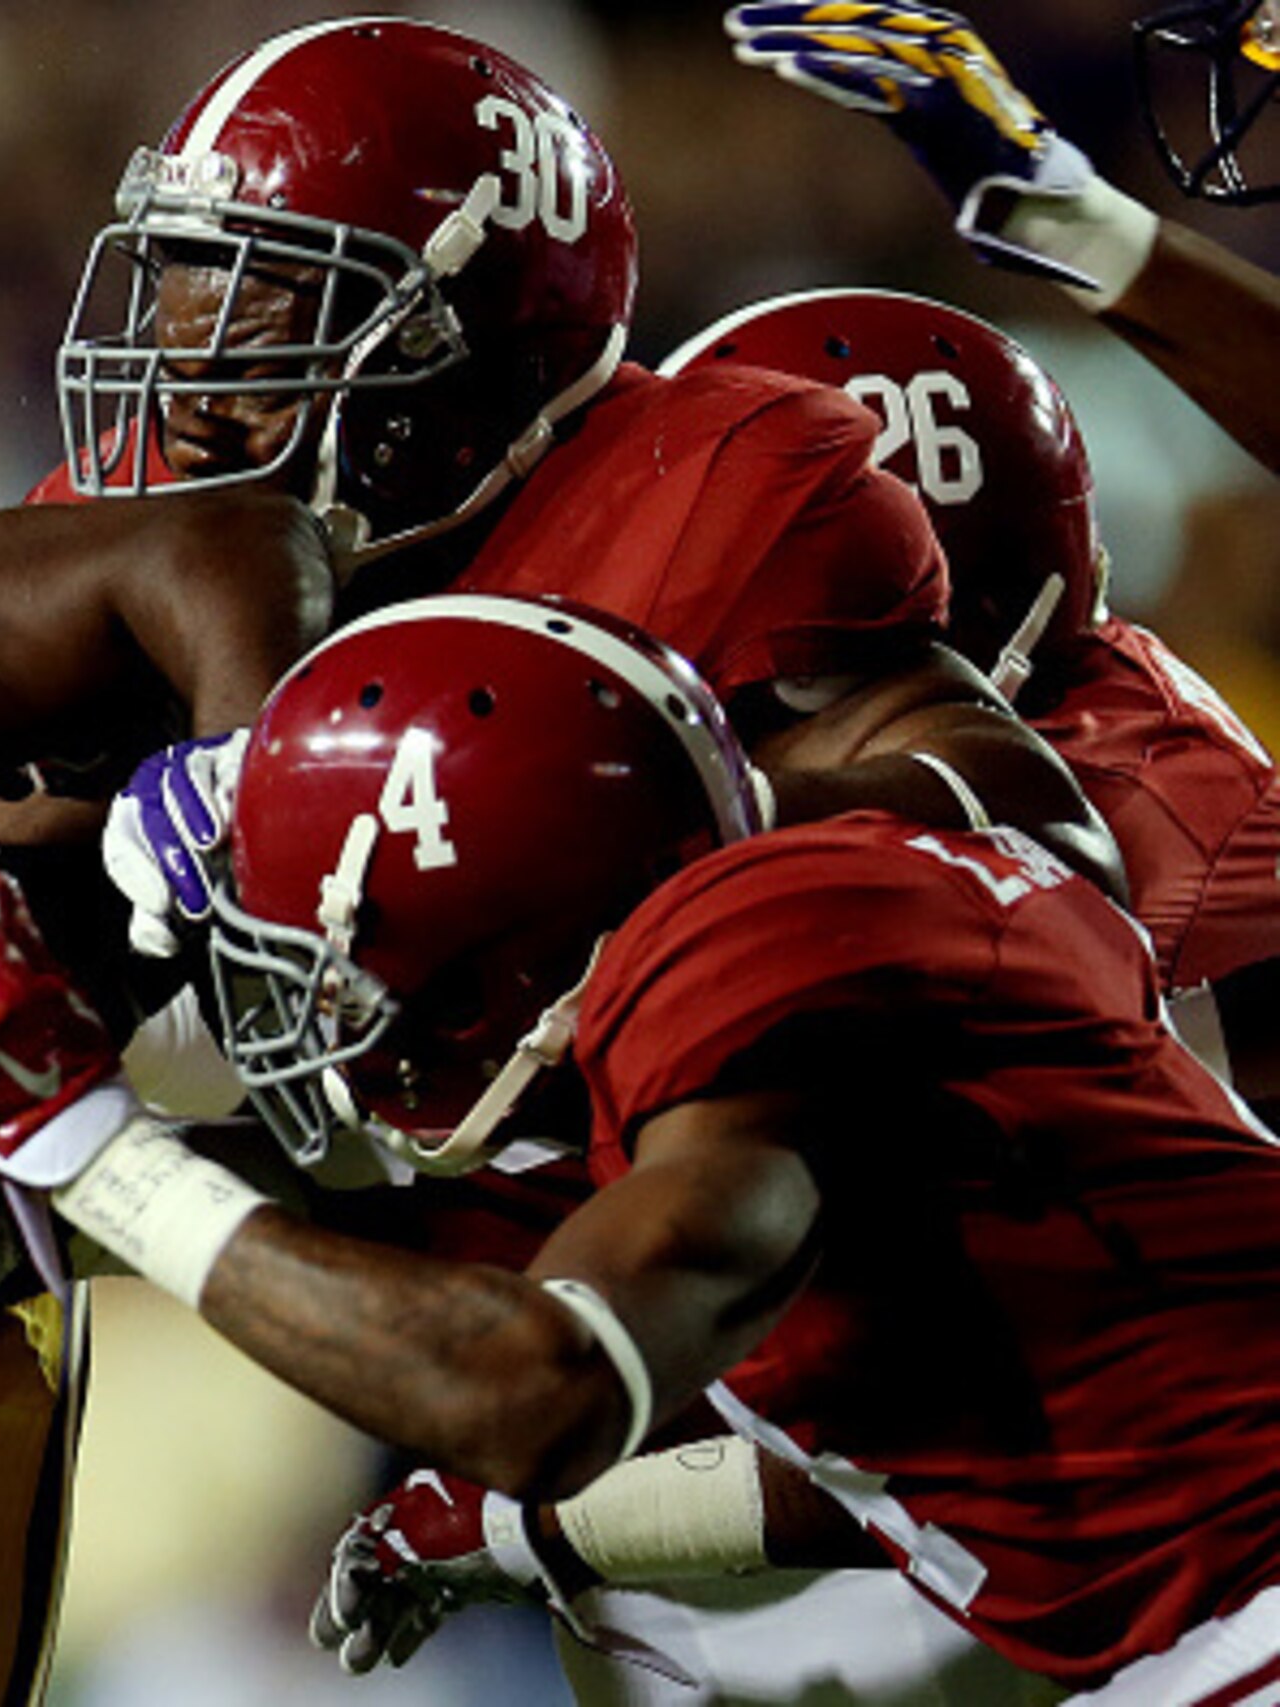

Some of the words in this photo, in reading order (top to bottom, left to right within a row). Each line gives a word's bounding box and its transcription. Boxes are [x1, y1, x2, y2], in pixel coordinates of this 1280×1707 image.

[474, 95, 587, 244] 30
[844, 371, 984, 505] 26
[379, 727, 458, 870] 4
